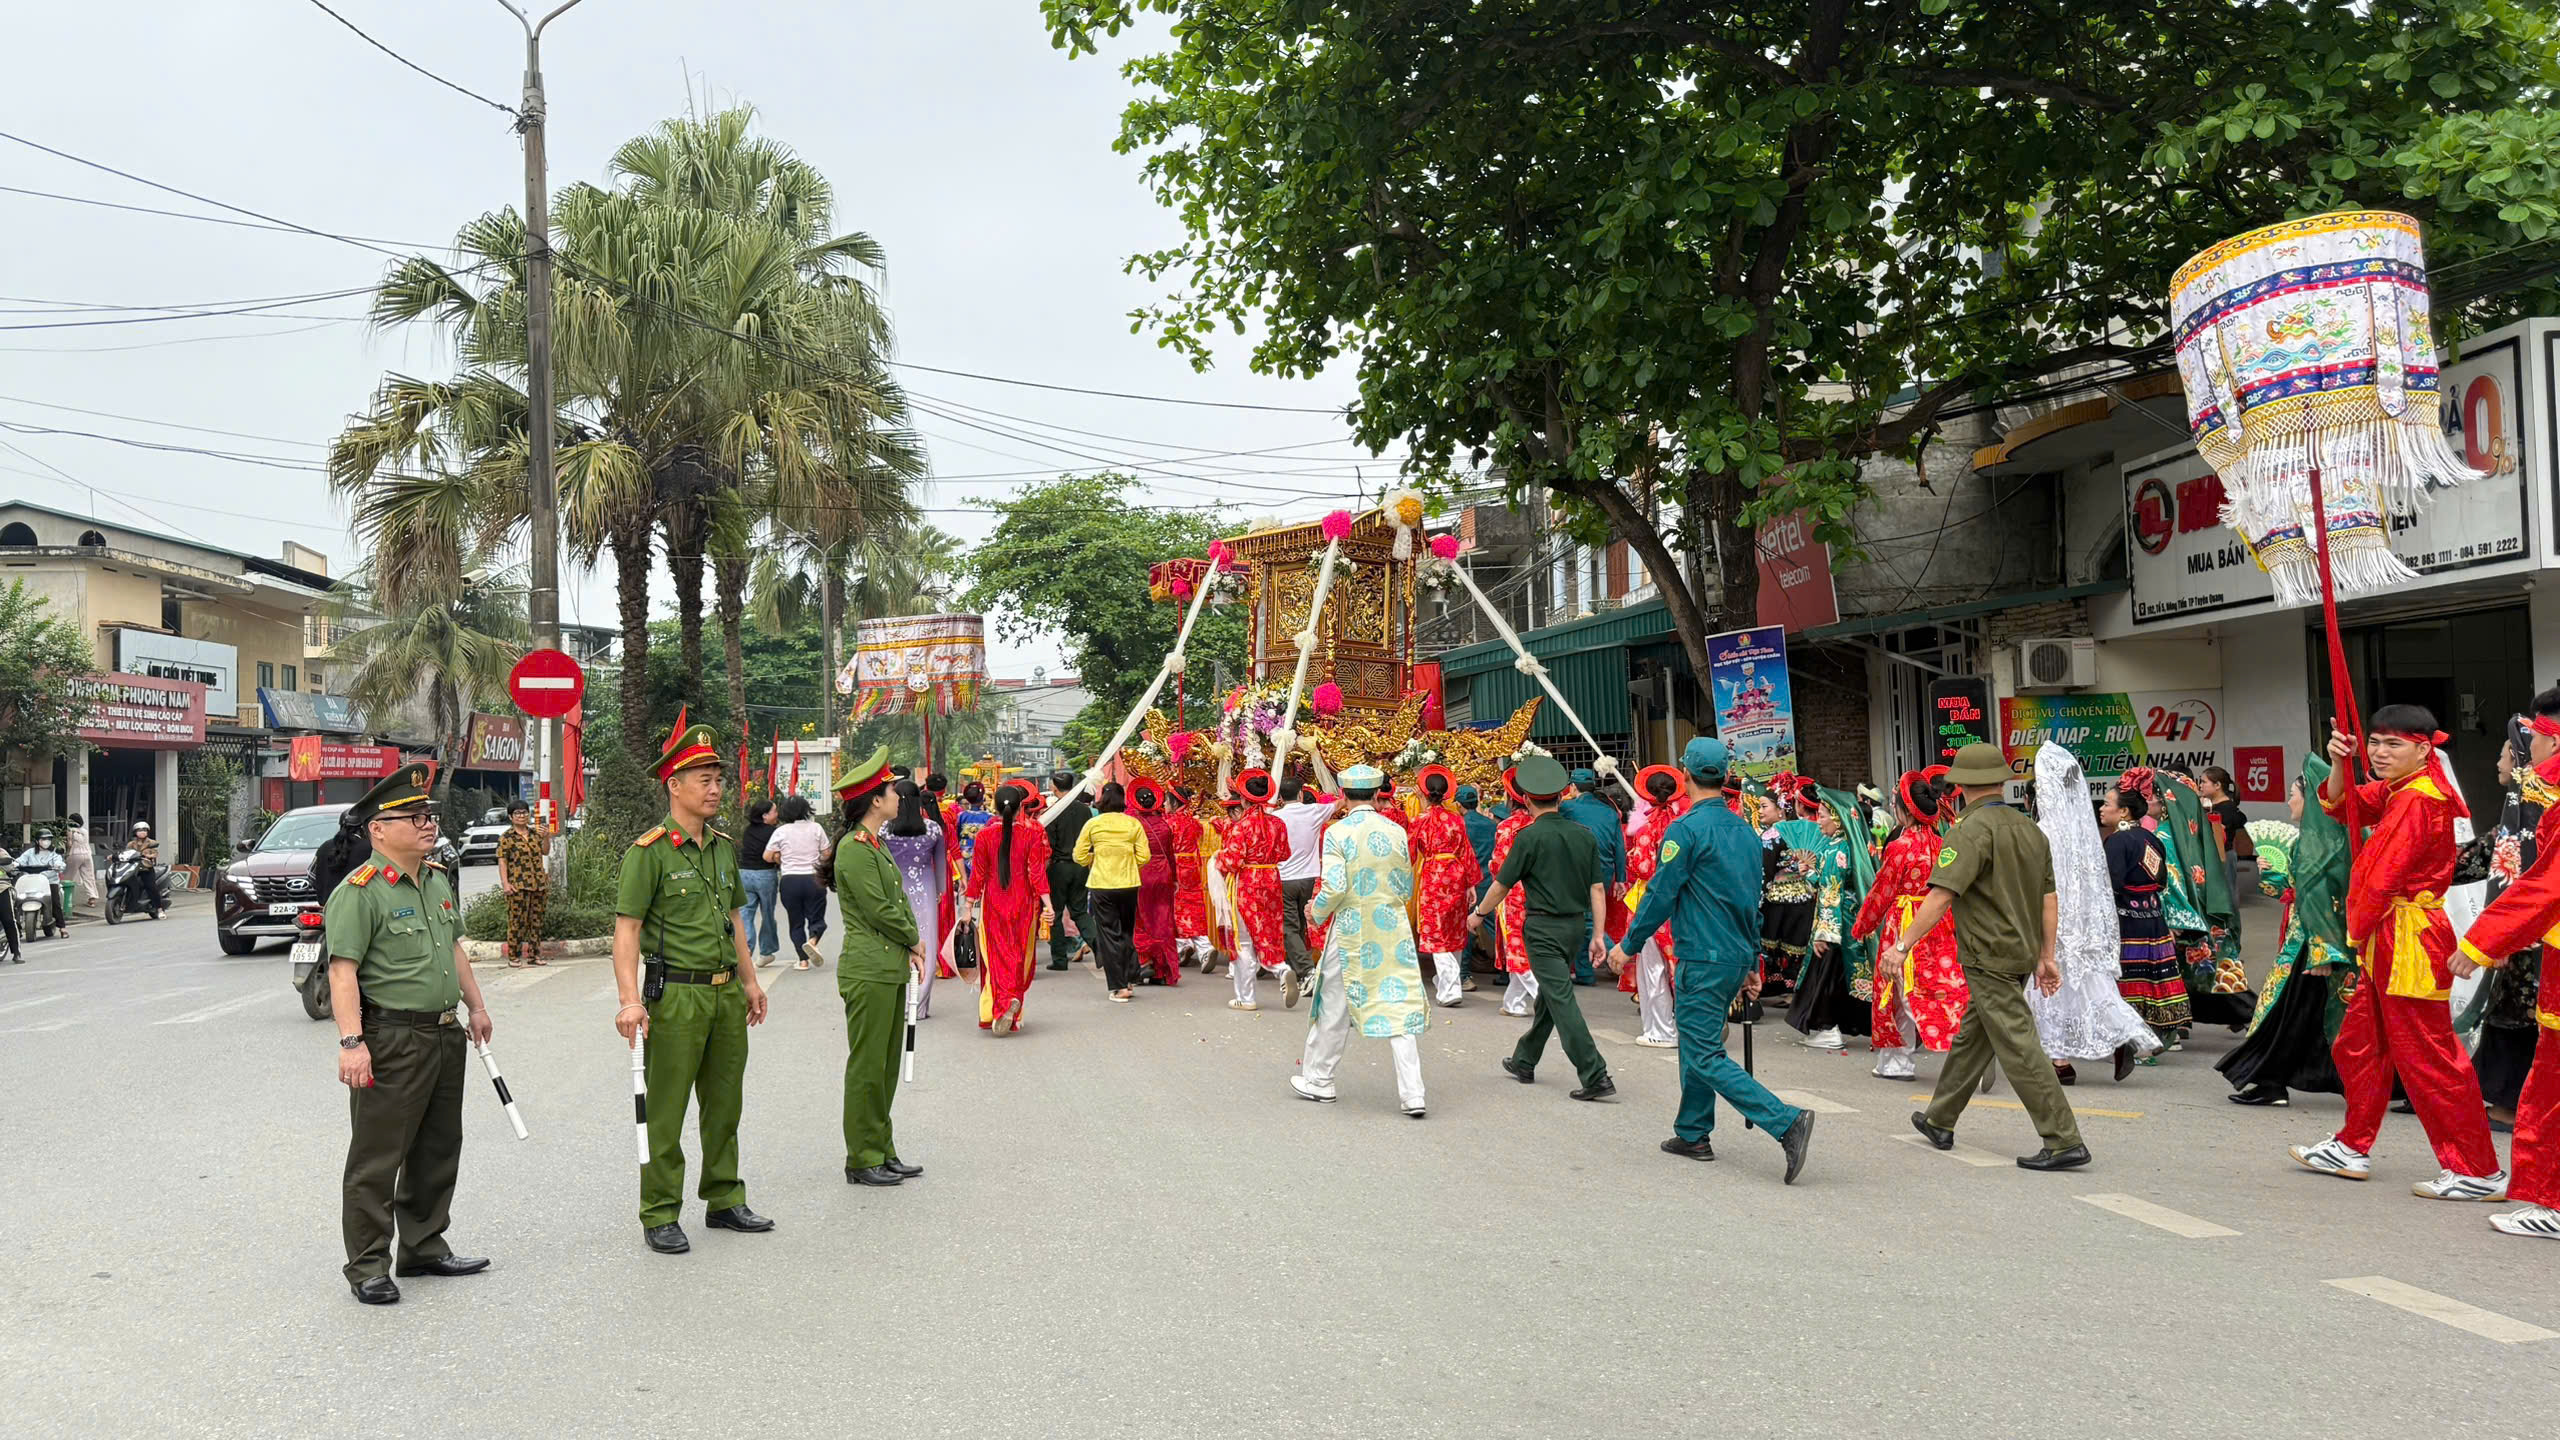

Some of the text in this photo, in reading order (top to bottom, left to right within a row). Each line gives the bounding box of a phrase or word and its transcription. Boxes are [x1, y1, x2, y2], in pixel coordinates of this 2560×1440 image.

[2187, 540, 2245, 575] MUA BÁN
[2478, 542, 2492, 555] 591
[2496, 538, 2518, 552] 2222
[1780, 565, 1811, 589] telecom
[168, 691, 191, 708] NAM
[483, 734, 521, 761] SAIGON
[2009, 721, 2051, 747] ĐIỂM
[2056, 726, 2090, 752] NẠP
[2105, 721, 2138, 743] RÚT
[2097, 749, 2141, 771] TIỀN
[2145, 751, 2215, 770] NHANH
[2248, 767, 2269, 792] 5G
